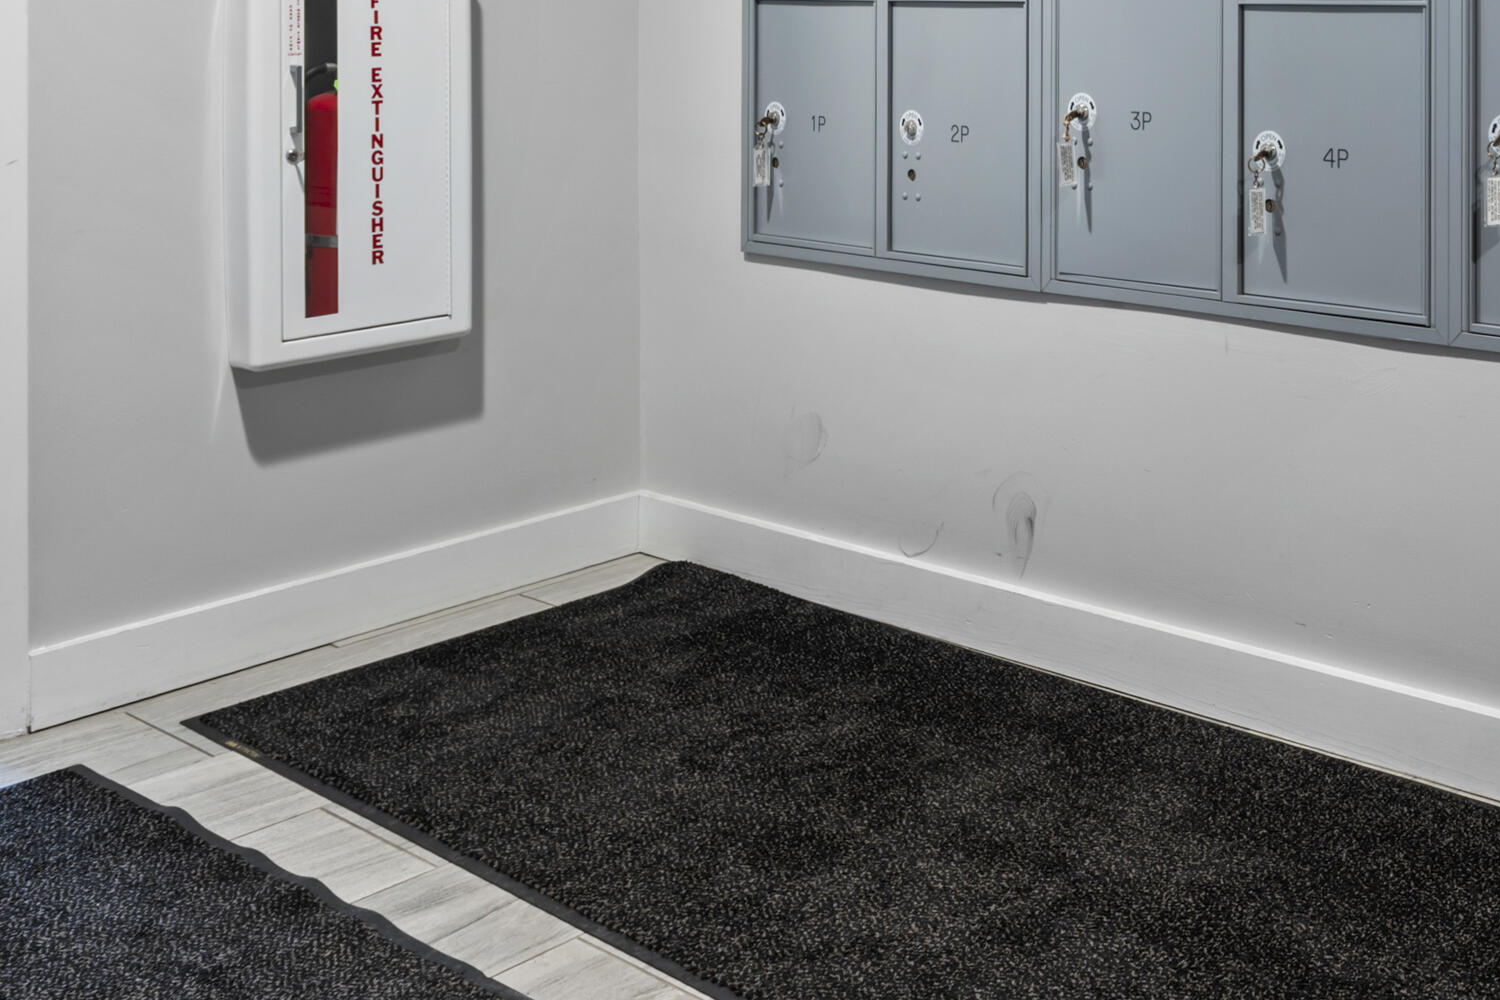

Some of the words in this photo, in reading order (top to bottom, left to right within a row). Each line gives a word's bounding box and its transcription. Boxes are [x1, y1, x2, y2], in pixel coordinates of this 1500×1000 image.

[811, 115, 827, 133] 1P
[1130, 110, 1153, 131] 3P
[950, 124, 970, 144] 2P
[371, 67, 384, 265] EXTINGUISHER
[1322, 147, 1349, 169] 4P
